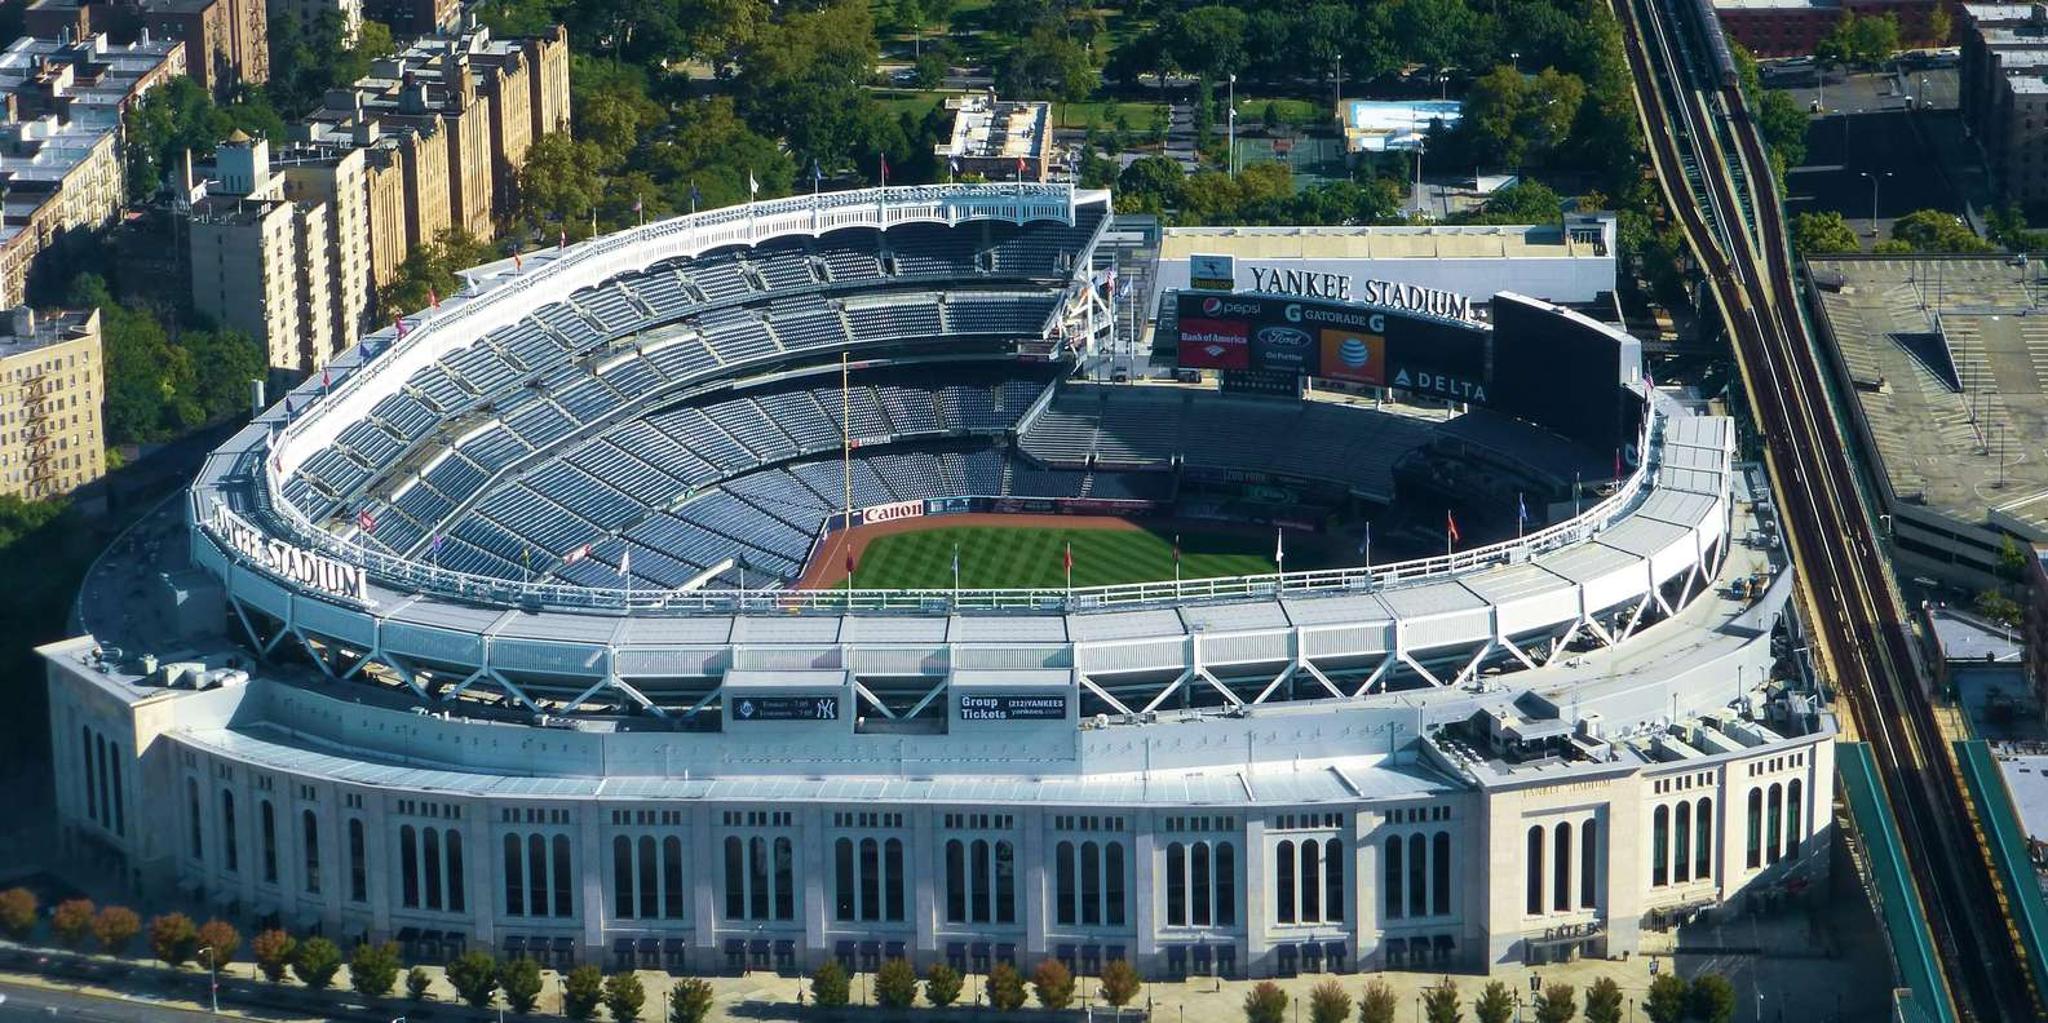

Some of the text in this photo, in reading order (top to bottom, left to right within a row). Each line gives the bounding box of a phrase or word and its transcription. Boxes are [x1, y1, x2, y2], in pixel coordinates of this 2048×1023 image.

[1250, 267, 1471, 321] YANKEE STADIUM
[1223, 302, 1261, 315] pepsi
[1304, 309, 1366, 326] GATORADE
[1181, 332, 1247, 345] Bank of America
[1268, 330, 1302, 345] Ford
[1418, 371, 1486, 402] DELTA
[865, 503, 922, 522] Canon
[961, 696, 998, 708] Group
[961, 708, 1007, 719] Tickets
